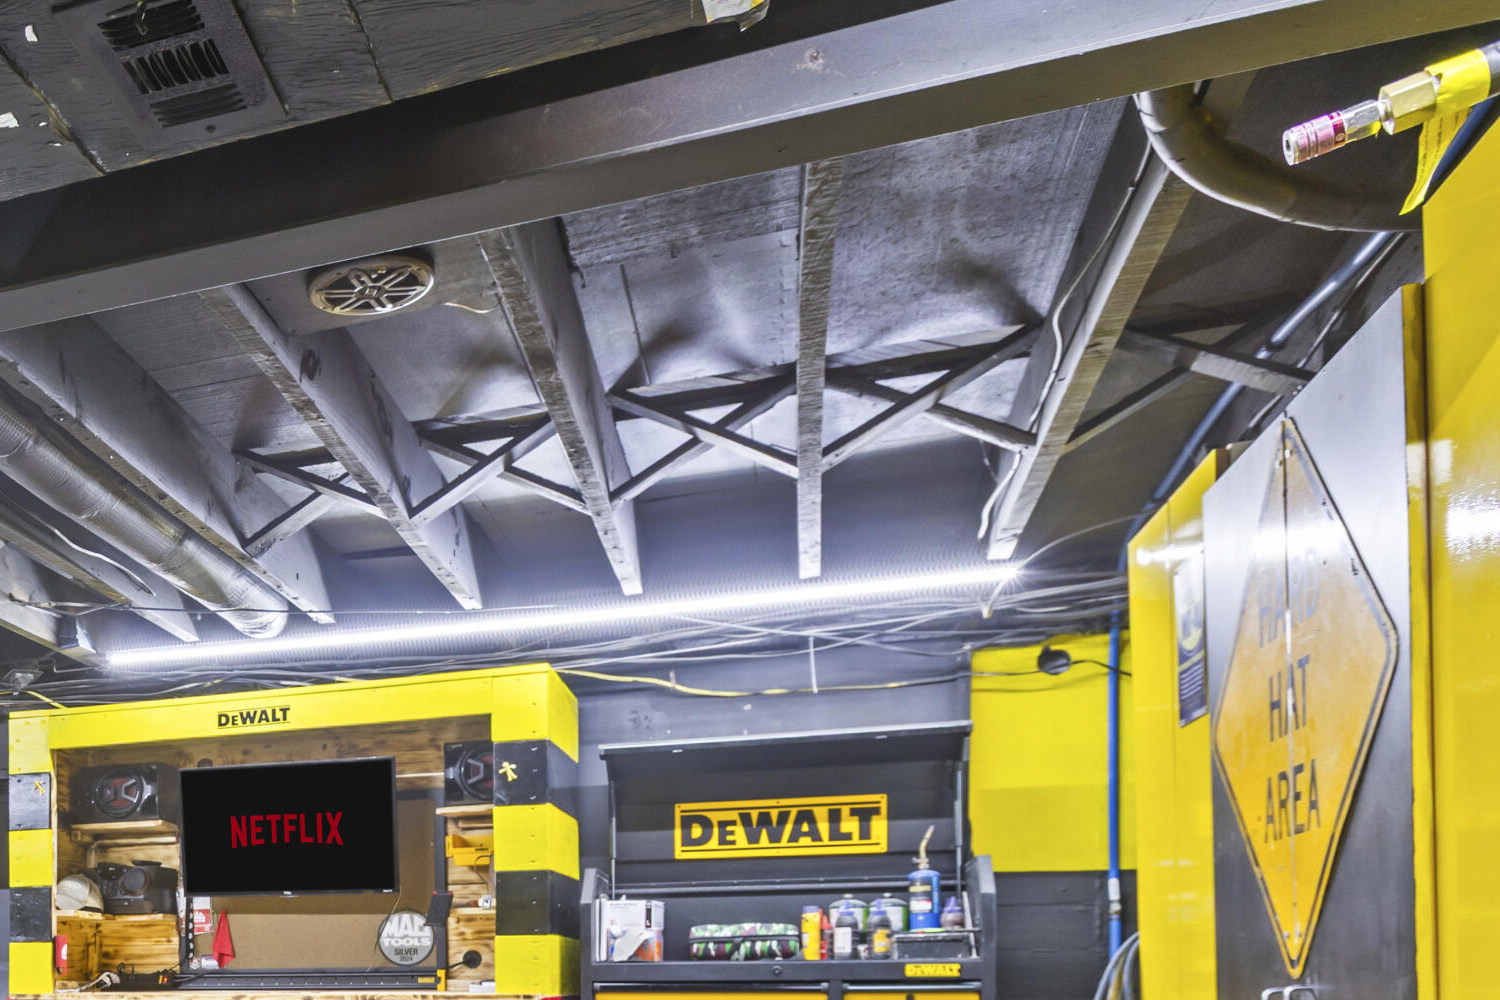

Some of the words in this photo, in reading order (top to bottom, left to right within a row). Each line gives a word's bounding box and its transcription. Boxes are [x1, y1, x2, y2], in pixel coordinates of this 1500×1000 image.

[1260, 547, 1319, 649] HARD
[1269, 654, 1310, 742] HAT
[218, 707, 290, 727] DEWALT
[1265, 758, 1321, 843] AREA
[230, 812, 344, 849] NETFLIX
[680, 806, 881, 847] DEWALT
[380, 913, 432, 938] MAC
[383, 937, 432, 947] TOOLS
[394, 948, 419, 956] SILVER
